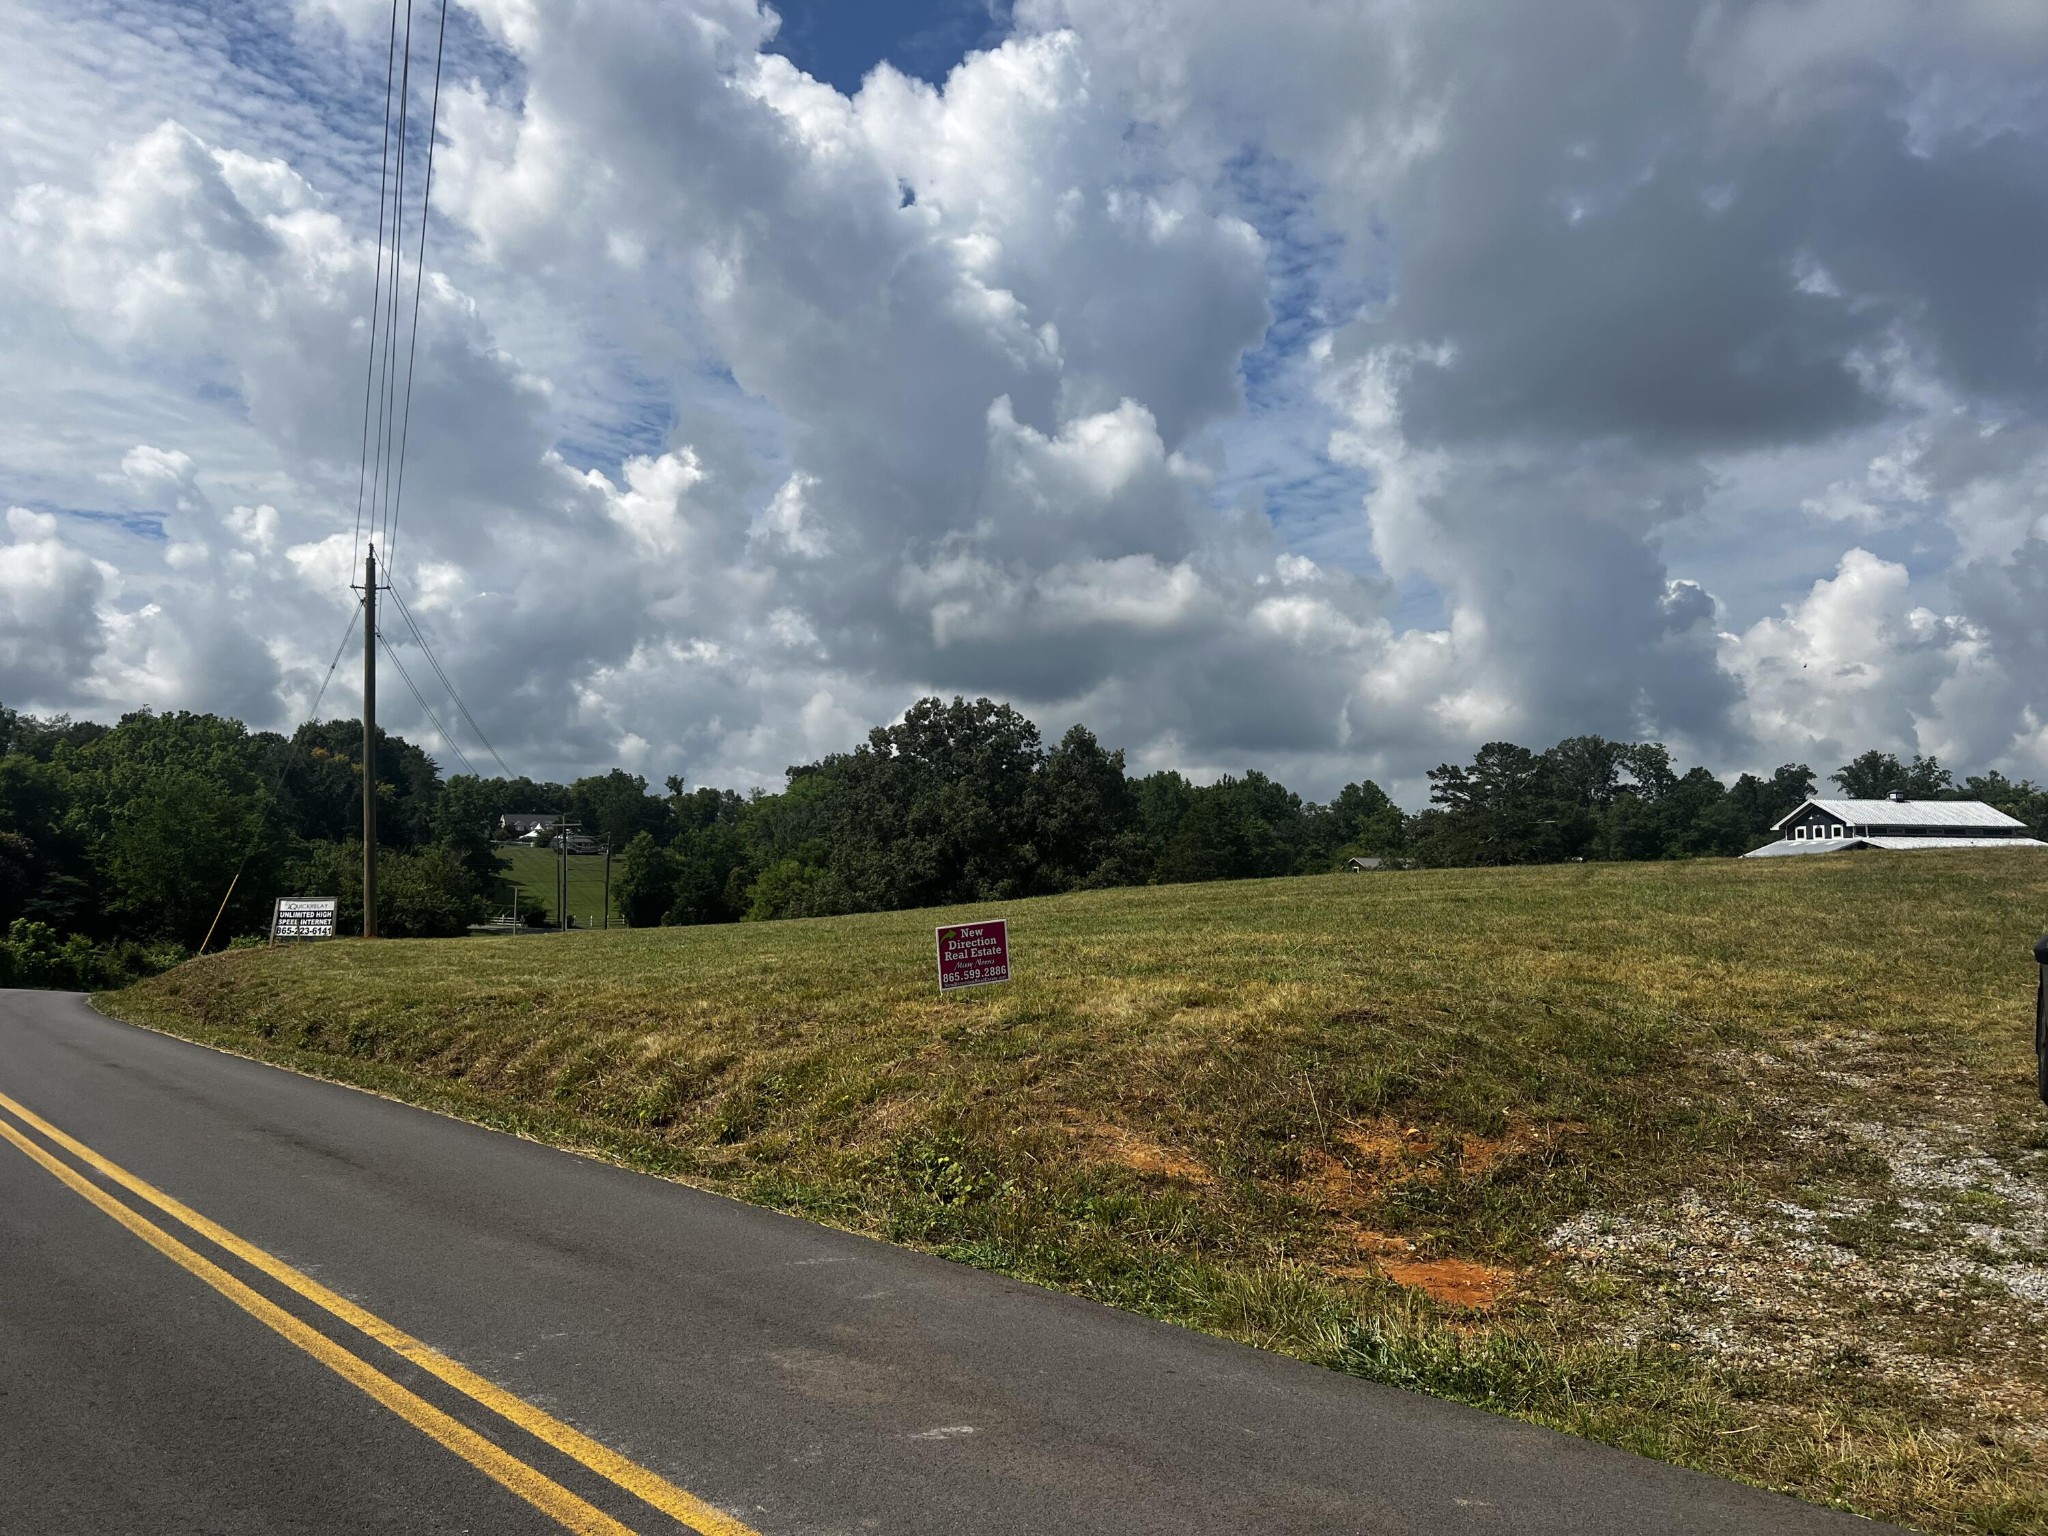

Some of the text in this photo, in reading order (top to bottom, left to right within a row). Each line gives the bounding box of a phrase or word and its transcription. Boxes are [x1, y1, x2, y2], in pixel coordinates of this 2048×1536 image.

[961, 928, 984, 938] New
[948, 937, 997, 950] Direction
[945, 946, 1002, 961] Real Estate
[943, 965, 1006, 983] 865.599.2886
